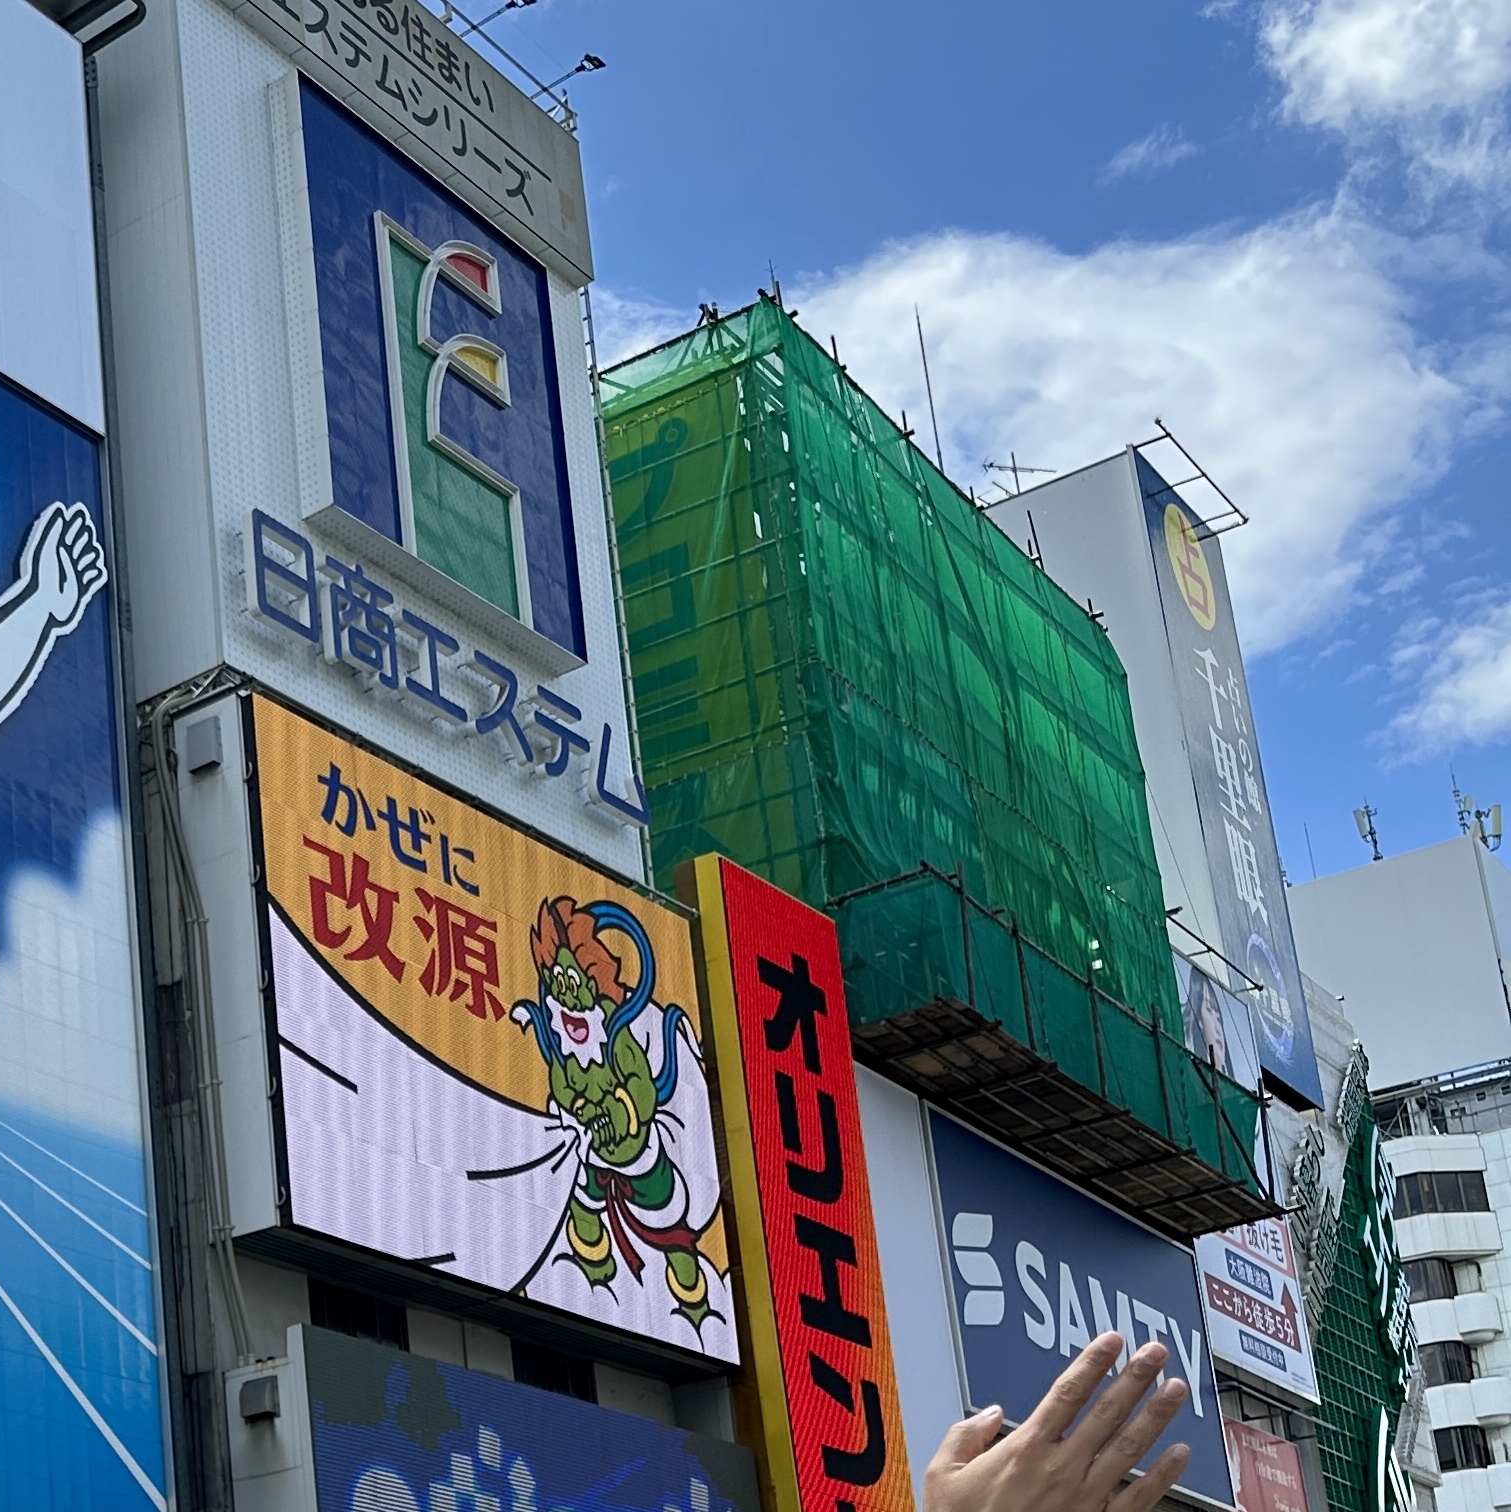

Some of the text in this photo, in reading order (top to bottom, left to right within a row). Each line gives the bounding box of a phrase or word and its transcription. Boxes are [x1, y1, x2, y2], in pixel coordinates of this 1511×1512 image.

[357, 0, 494, 112] る住まい
[251, 508, 653, 826] 日商エステム
[317, 761, 481, 897] かぜに
[1192, 646, 1269, 928] 千里眼
[302, 835, 506, 1023] 改源
[1212, 1282, 1295, 1347] ここから徒歩5分
